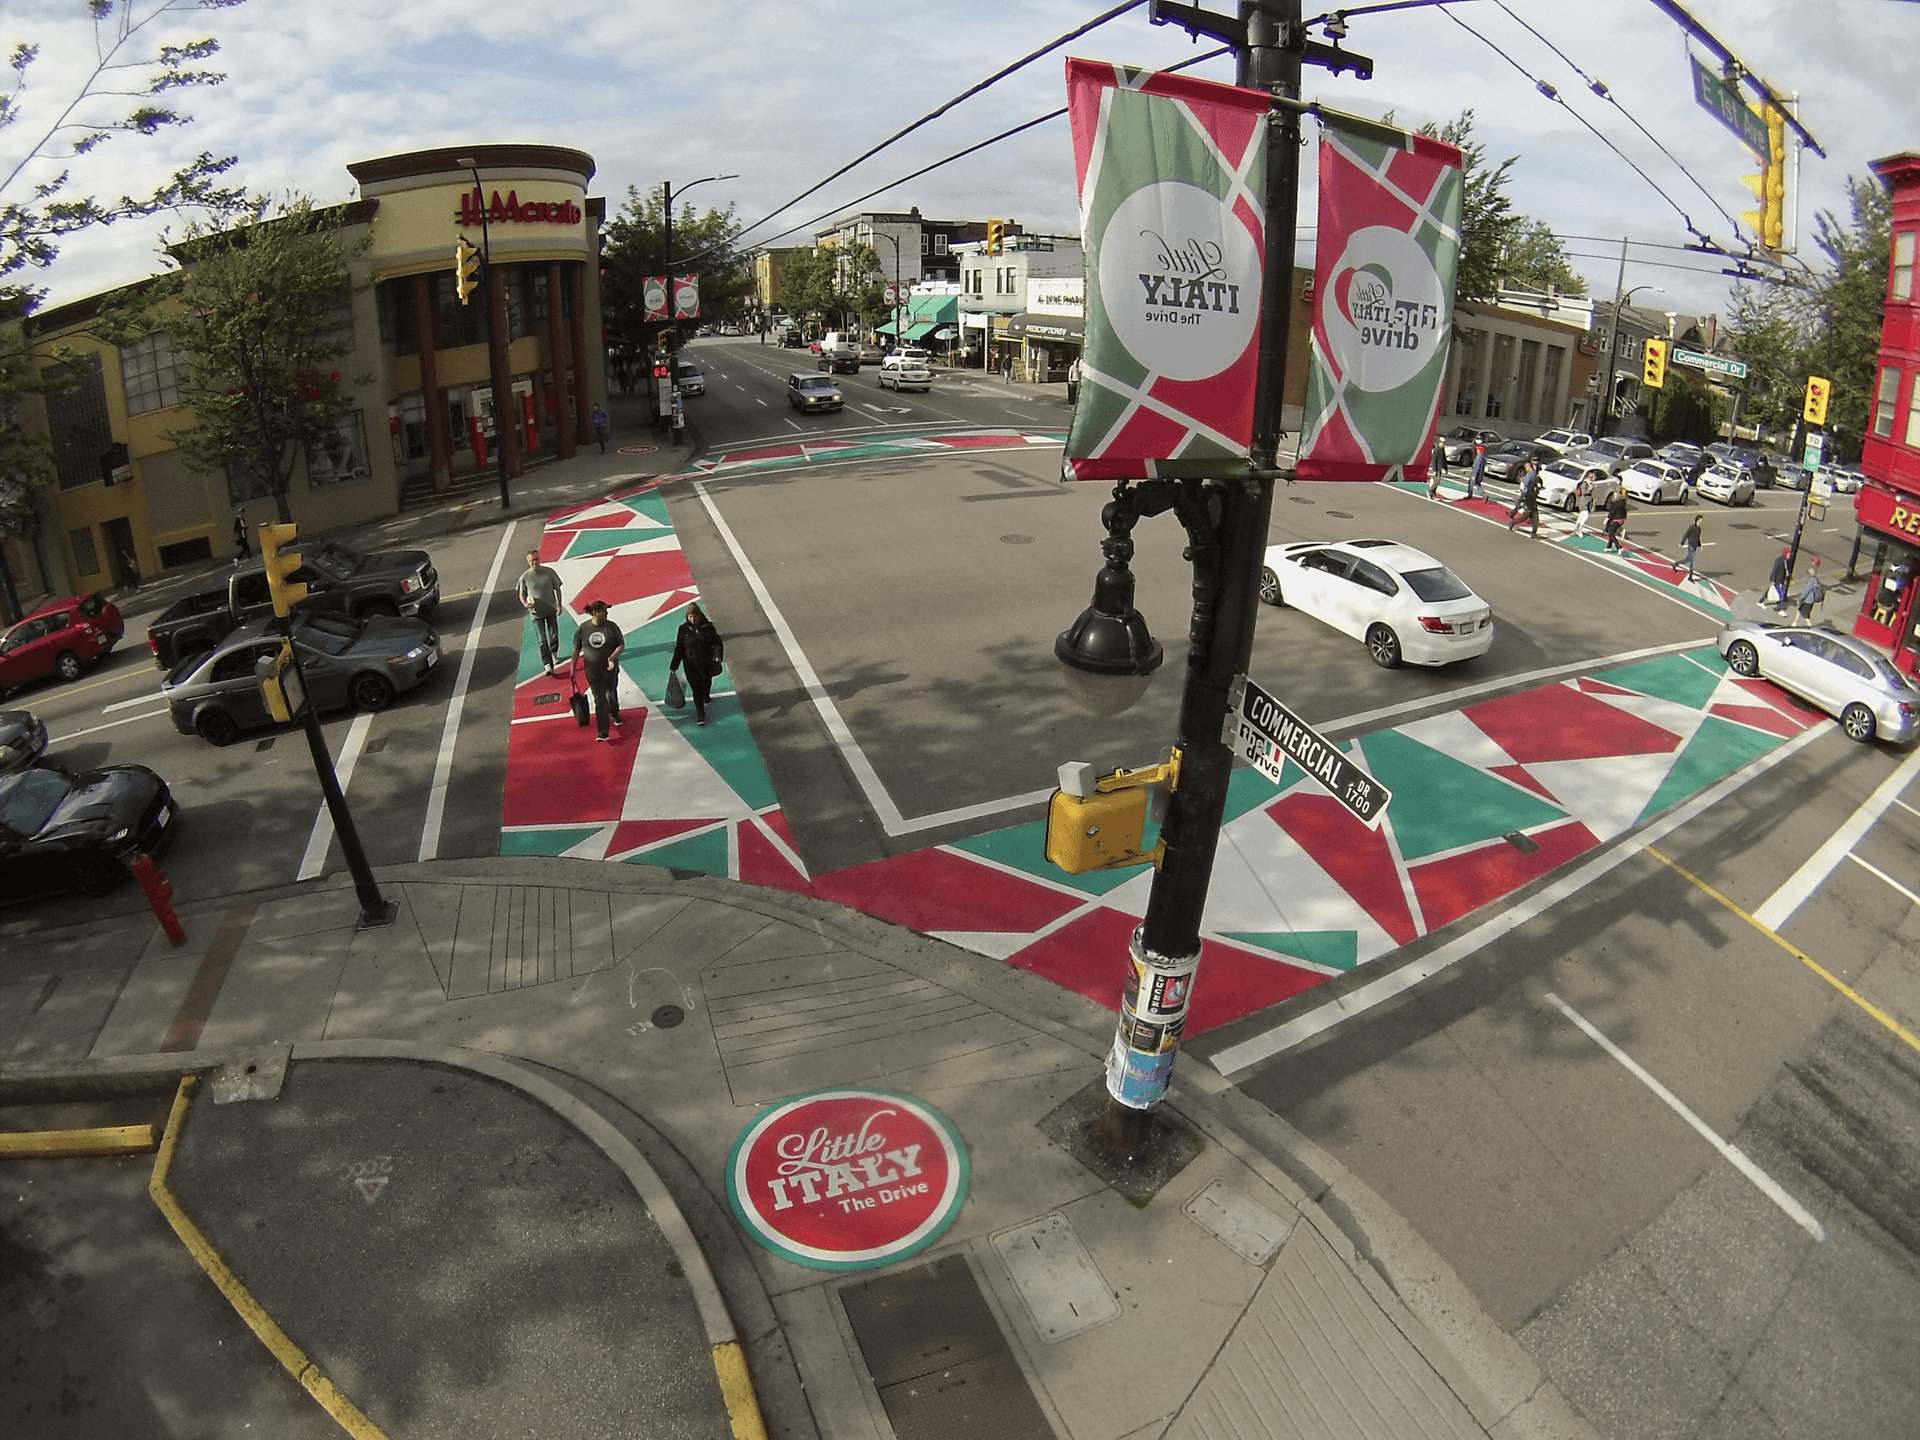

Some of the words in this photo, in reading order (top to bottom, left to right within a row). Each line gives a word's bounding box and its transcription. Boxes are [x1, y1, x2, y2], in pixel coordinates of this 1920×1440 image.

[1701, 72, 1714, 106] E
[1717, 89, 1739, 129] 1st
[1744, 112, 1765, 151] Ave
[488, 190, 582, 224] Mercato
[1677, 352, 1728, 371] Commercial
[1730, 363, 1742, 374] Dr
[1889, 506, 1920, 535] RE
[1246, 746, 1280, 778] drive
[1250, 695, 1343, 789] COMMERCIAL
[1357, 779, 1371, 798] DR
[1345, 786, 1371, 814] 1700
[777, 1109, 897, 1175] Little
[767, 1143, 922, 1211] ITALY
[838, 1198, 876, 1213] The
[879, 1182, 929, 1204] Drive
